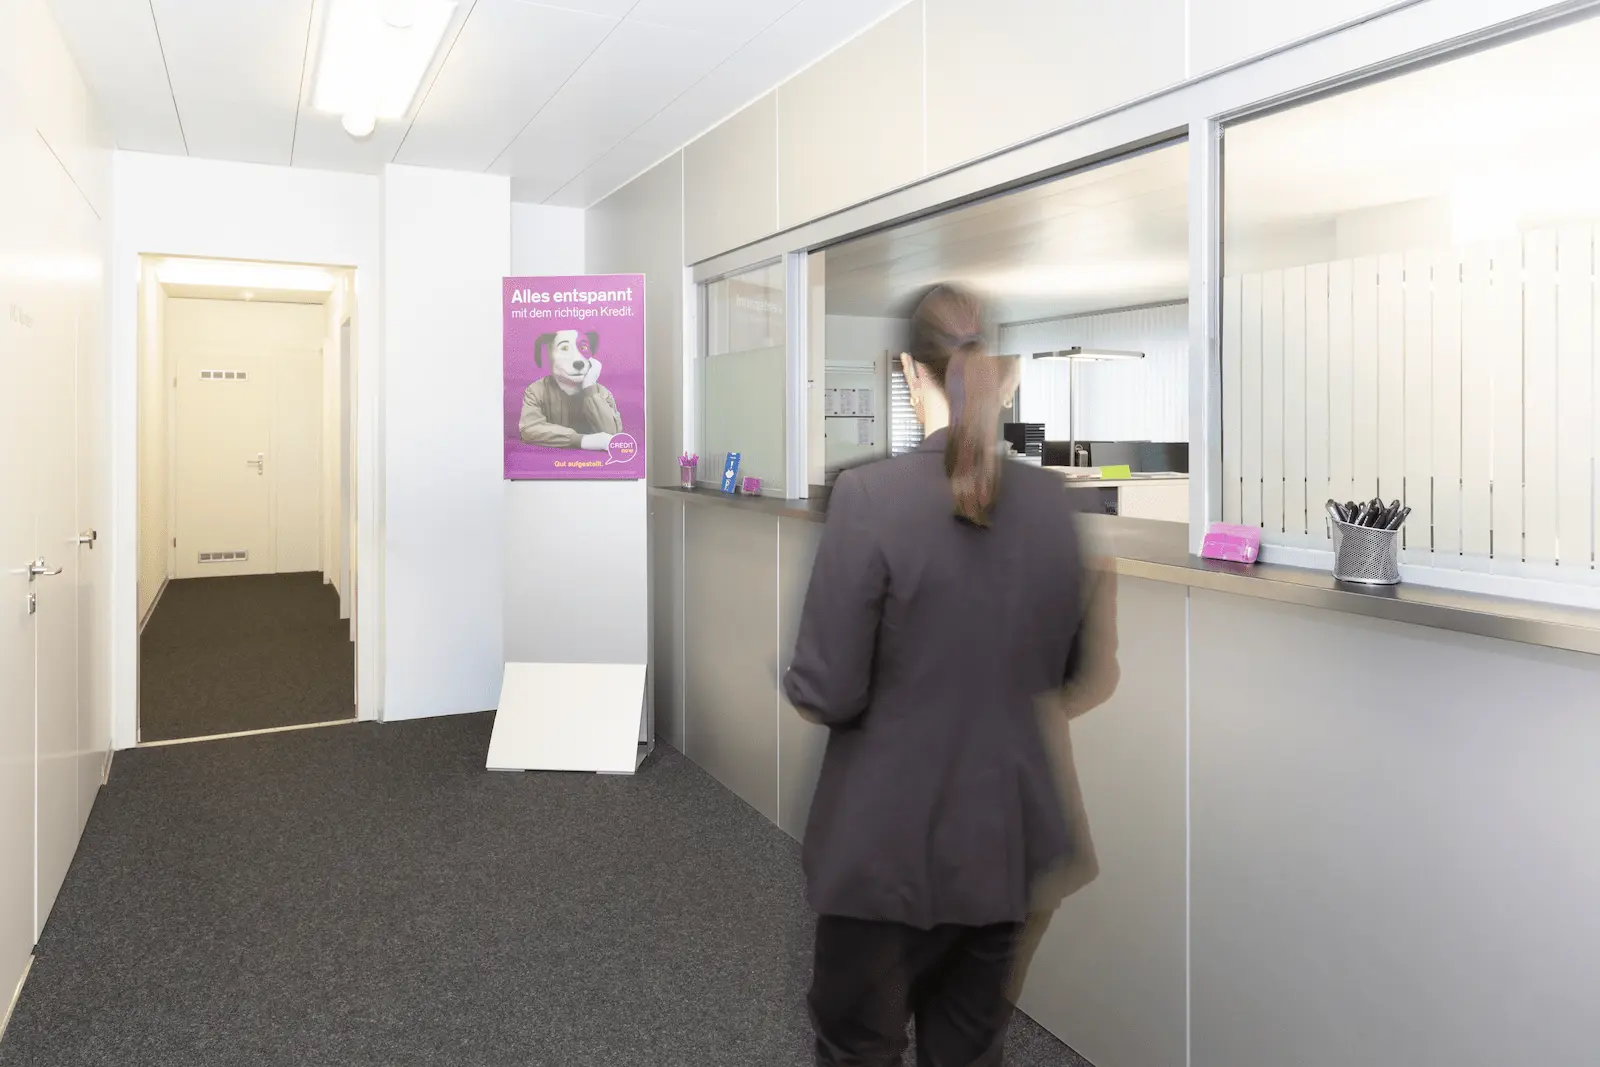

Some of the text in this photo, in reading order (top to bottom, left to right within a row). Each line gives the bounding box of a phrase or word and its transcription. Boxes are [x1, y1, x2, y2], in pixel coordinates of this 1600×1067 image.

[511, 287, 632, 304] Alles entspannt
[511, 305, 634, 320] mit dem richtigen Kredit.
